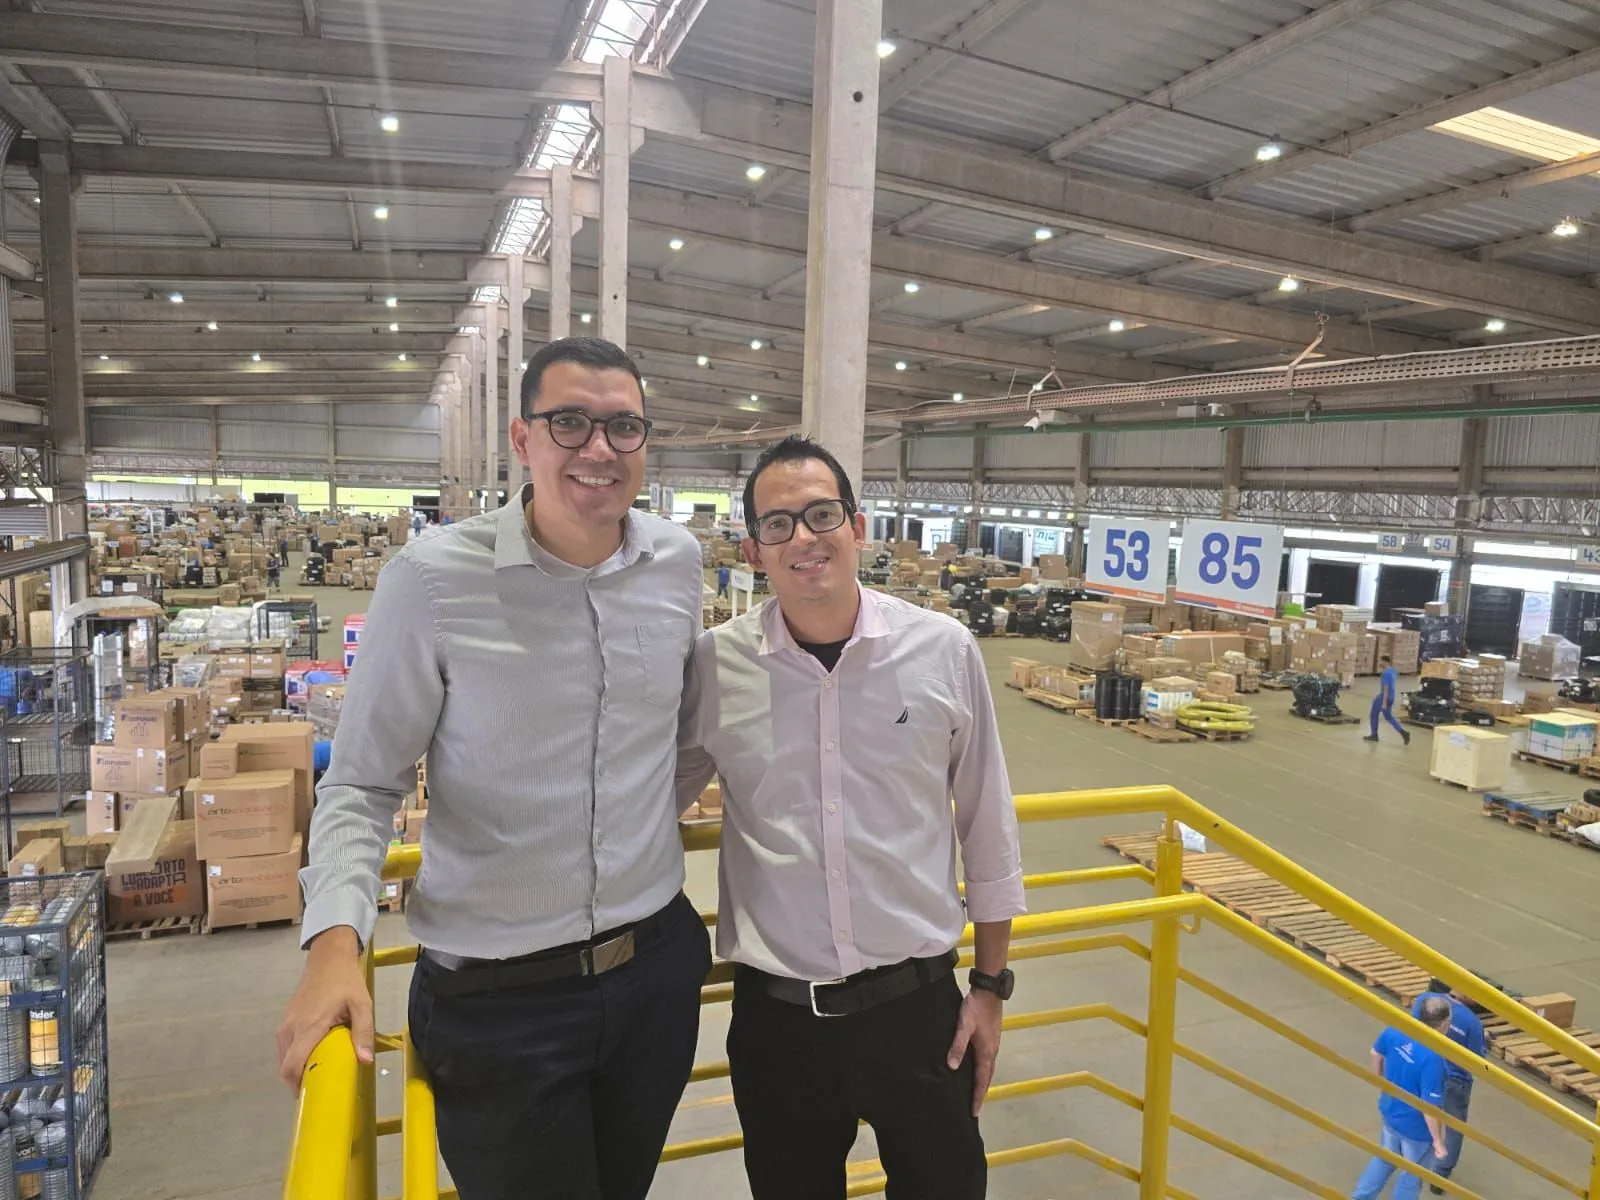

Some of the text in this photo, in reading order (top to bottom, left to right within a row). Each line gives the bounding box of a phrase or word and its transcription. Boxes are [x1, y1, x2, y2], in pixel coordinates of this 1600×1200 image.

[1104, 528, 1150, 581] 53
[1382, 535, 1397, 547] 58
[1434, 537, 1451, 551] 54
[1199, 532, 1263, 590] 85
